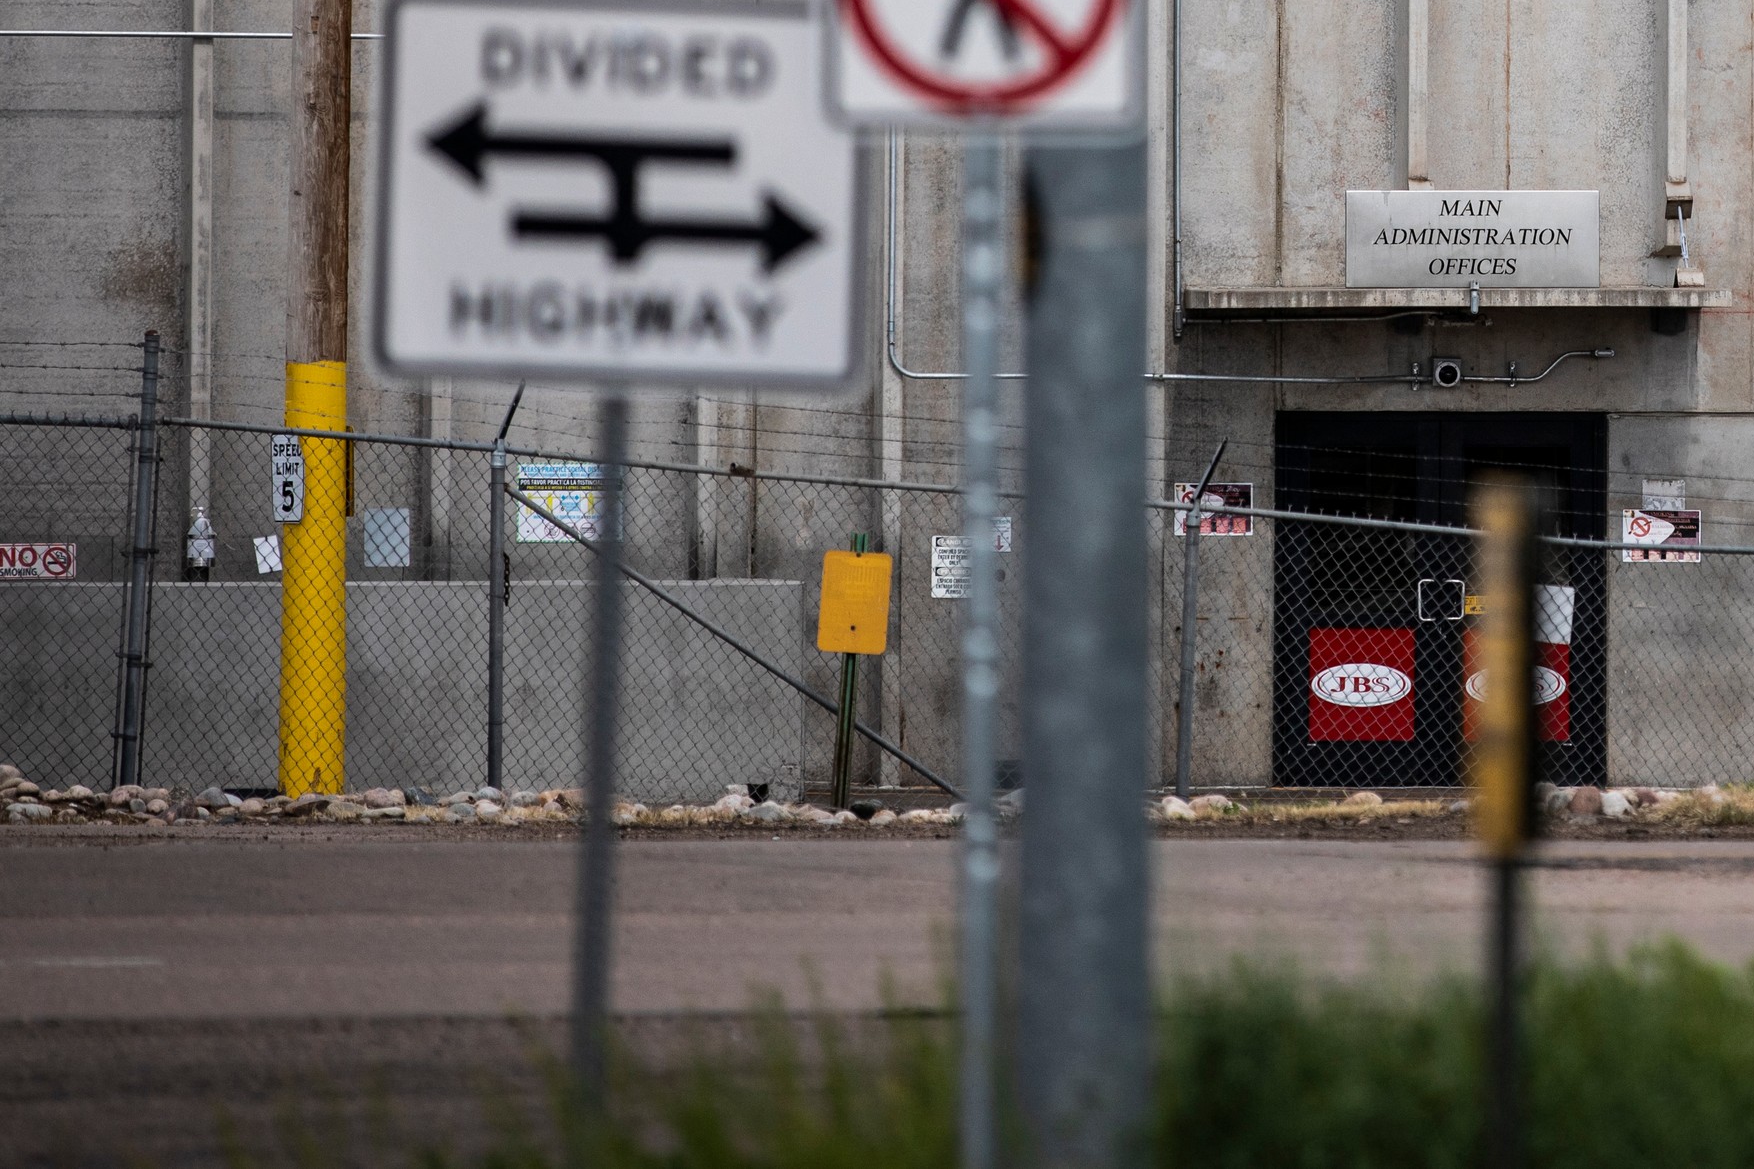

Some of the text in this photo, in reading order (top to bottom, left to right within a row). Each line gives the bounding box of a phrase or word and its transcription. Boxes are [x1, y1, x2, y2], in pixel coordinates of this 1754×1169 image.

[480, 27, 778, 98] DIVIDED
[1438, 200, 1502, 216] MAIN
[1373, 228, 1572, 245] ADMINISTRATION
[1428, 258, 1517, 275] OFFICES
[449, 279, 788, 351] HIGHWAY
[276, 462, 299, 476] LIMIT
[282, 481, 295, 512] 5
[0, 547, 38, 567] NO
[0, 568, 38, 576] SMOKING
[1330, 676, 1390, 693] JBS
